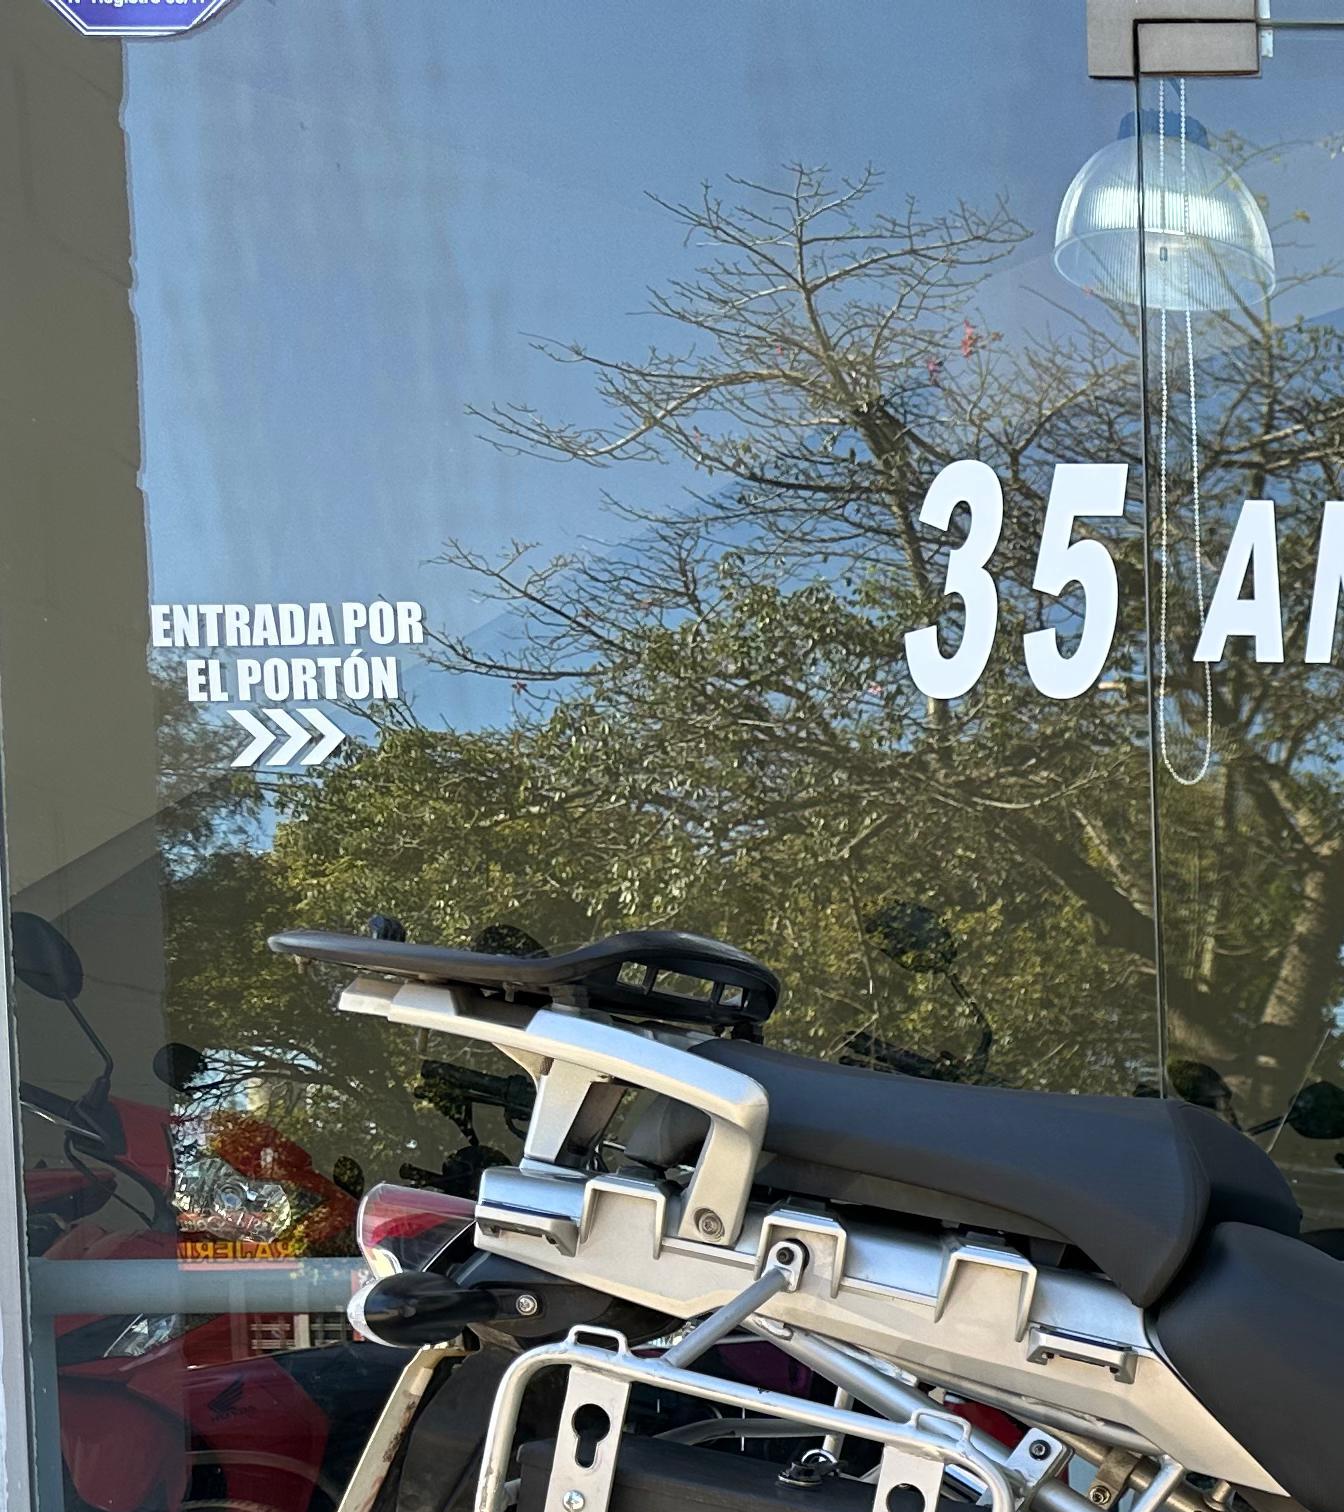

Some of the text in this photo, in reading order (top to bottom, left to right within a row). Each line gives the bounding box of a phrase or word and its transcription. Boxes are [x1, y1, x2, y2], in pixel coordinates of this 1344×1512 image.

[904, 459, 1129, 700] 35
[152, 601, 424, 648] ENTRADA POR
[187, 649, 398, 702] EL PORTÓN
